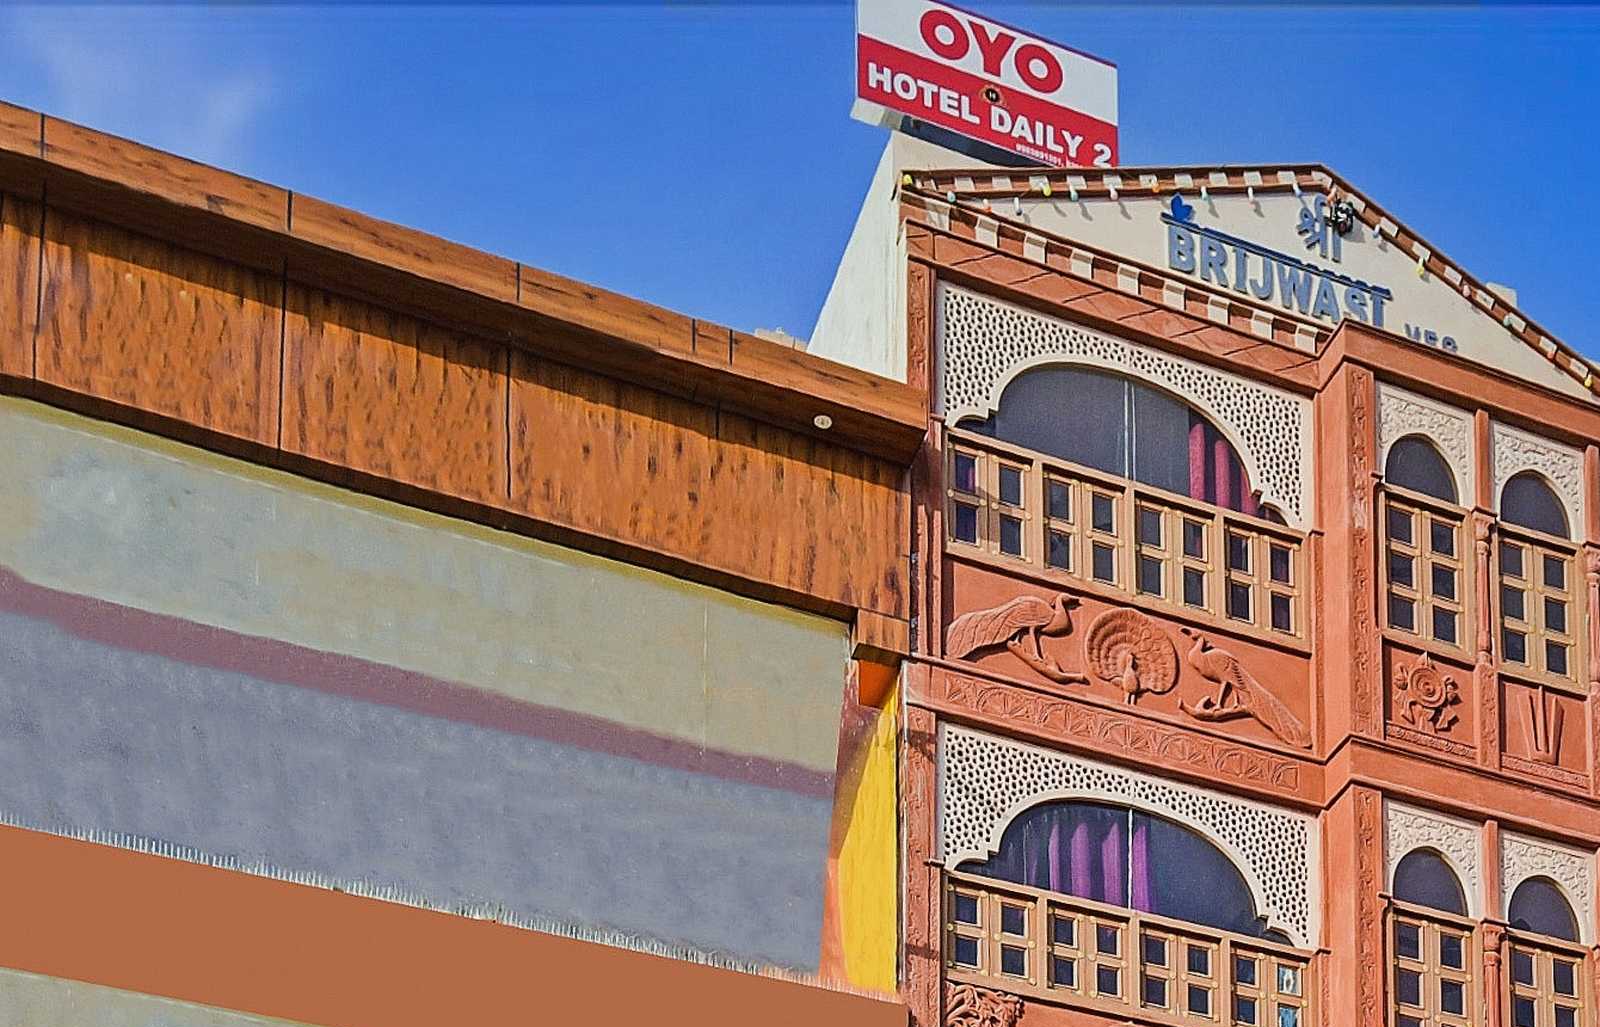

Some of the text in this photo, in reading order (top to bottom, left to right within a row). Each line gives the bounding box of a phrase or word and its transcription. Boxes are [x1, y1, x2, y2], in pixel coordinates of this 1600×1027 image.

[920, 9, 1064, 94] OYO
[867, 62, 981, 125] HOTEL
[990, 105, 1084, 158] DAILY
[1092, 143, 1113, 168] 2
